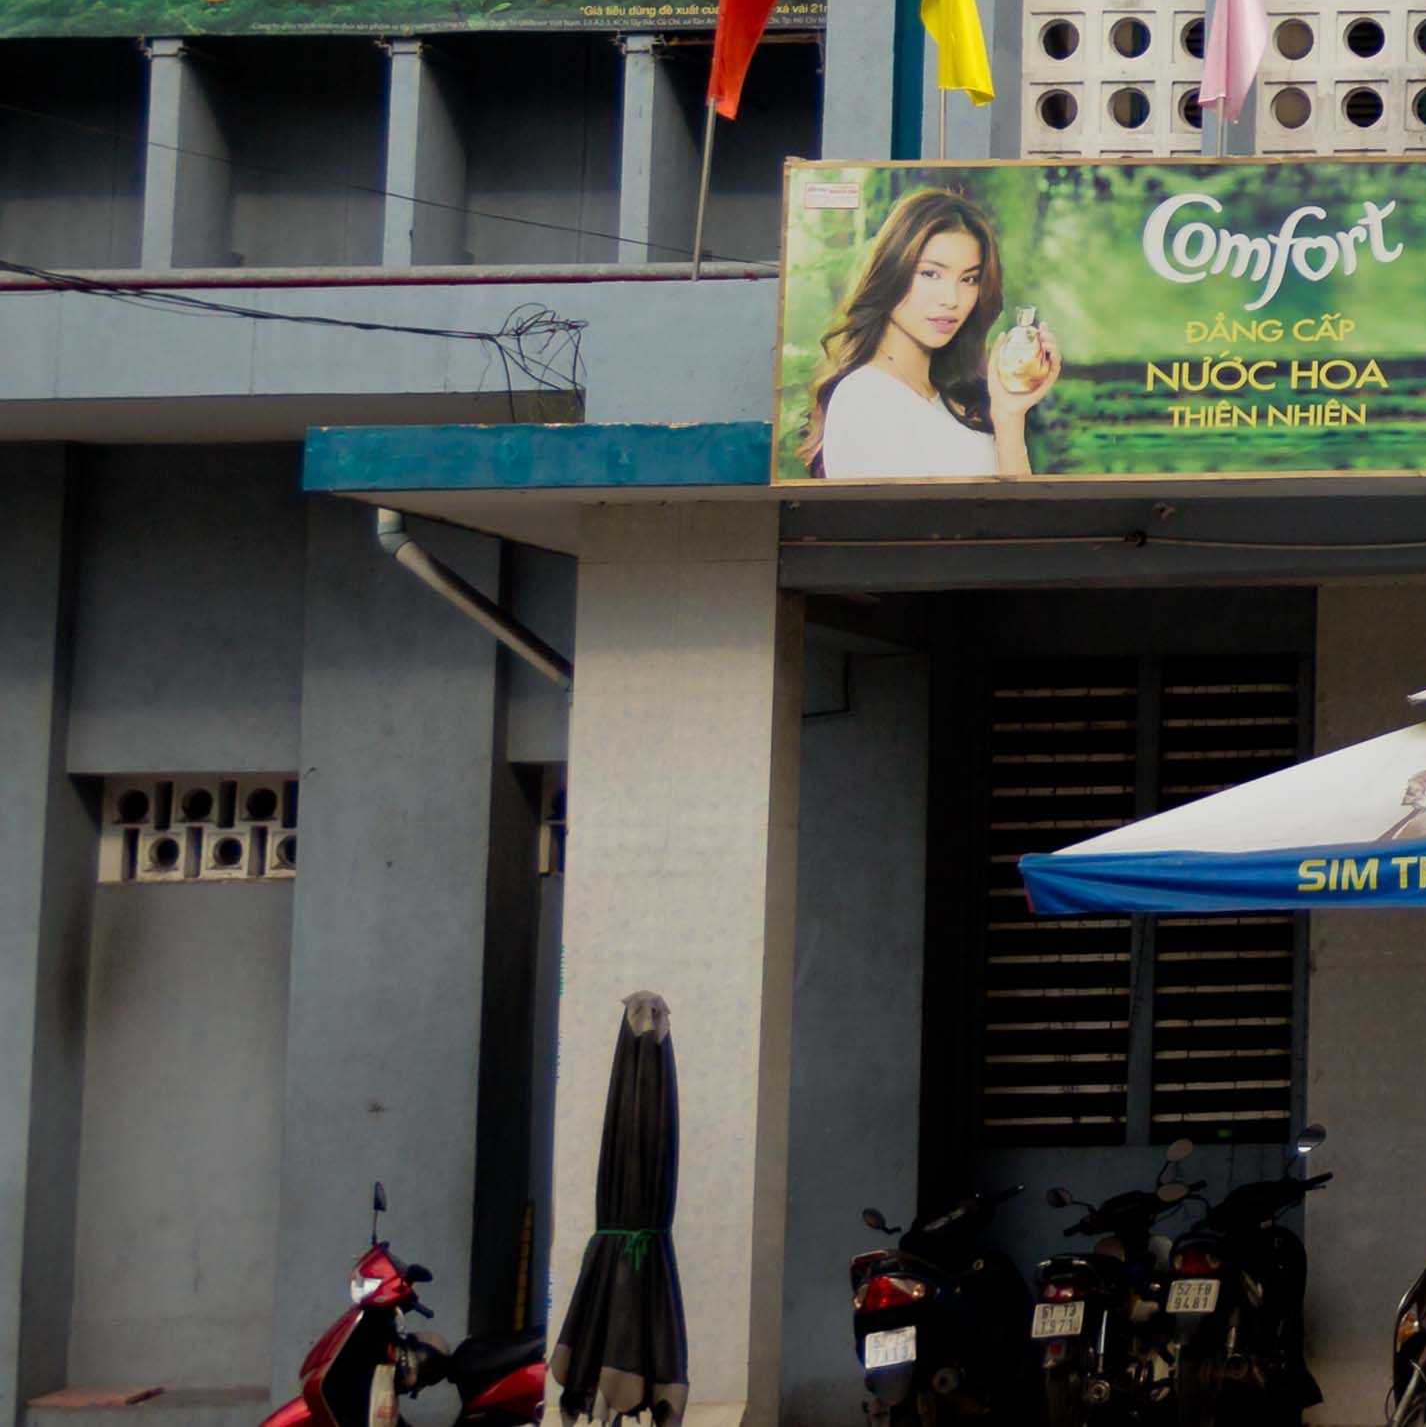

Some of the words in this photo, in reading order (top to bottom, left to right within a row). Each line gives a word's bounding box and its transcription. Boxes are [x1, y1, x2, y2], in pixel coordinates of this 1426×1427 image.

[1143, 193, 1404, 310] Comfort
[1186, 312, 1284, 343] ĐẲNG
[1292, 312, 1356, 342] CẤP
[1146, 350, 1277, 391] NƯỚC
[1291, 359, 1389, 390] HOA
[1168, 399, 1257, 428] THIÊN
[1268, 398, 1367, 427] NHIÊN
[1297, 858, 1379, 891] SIM
